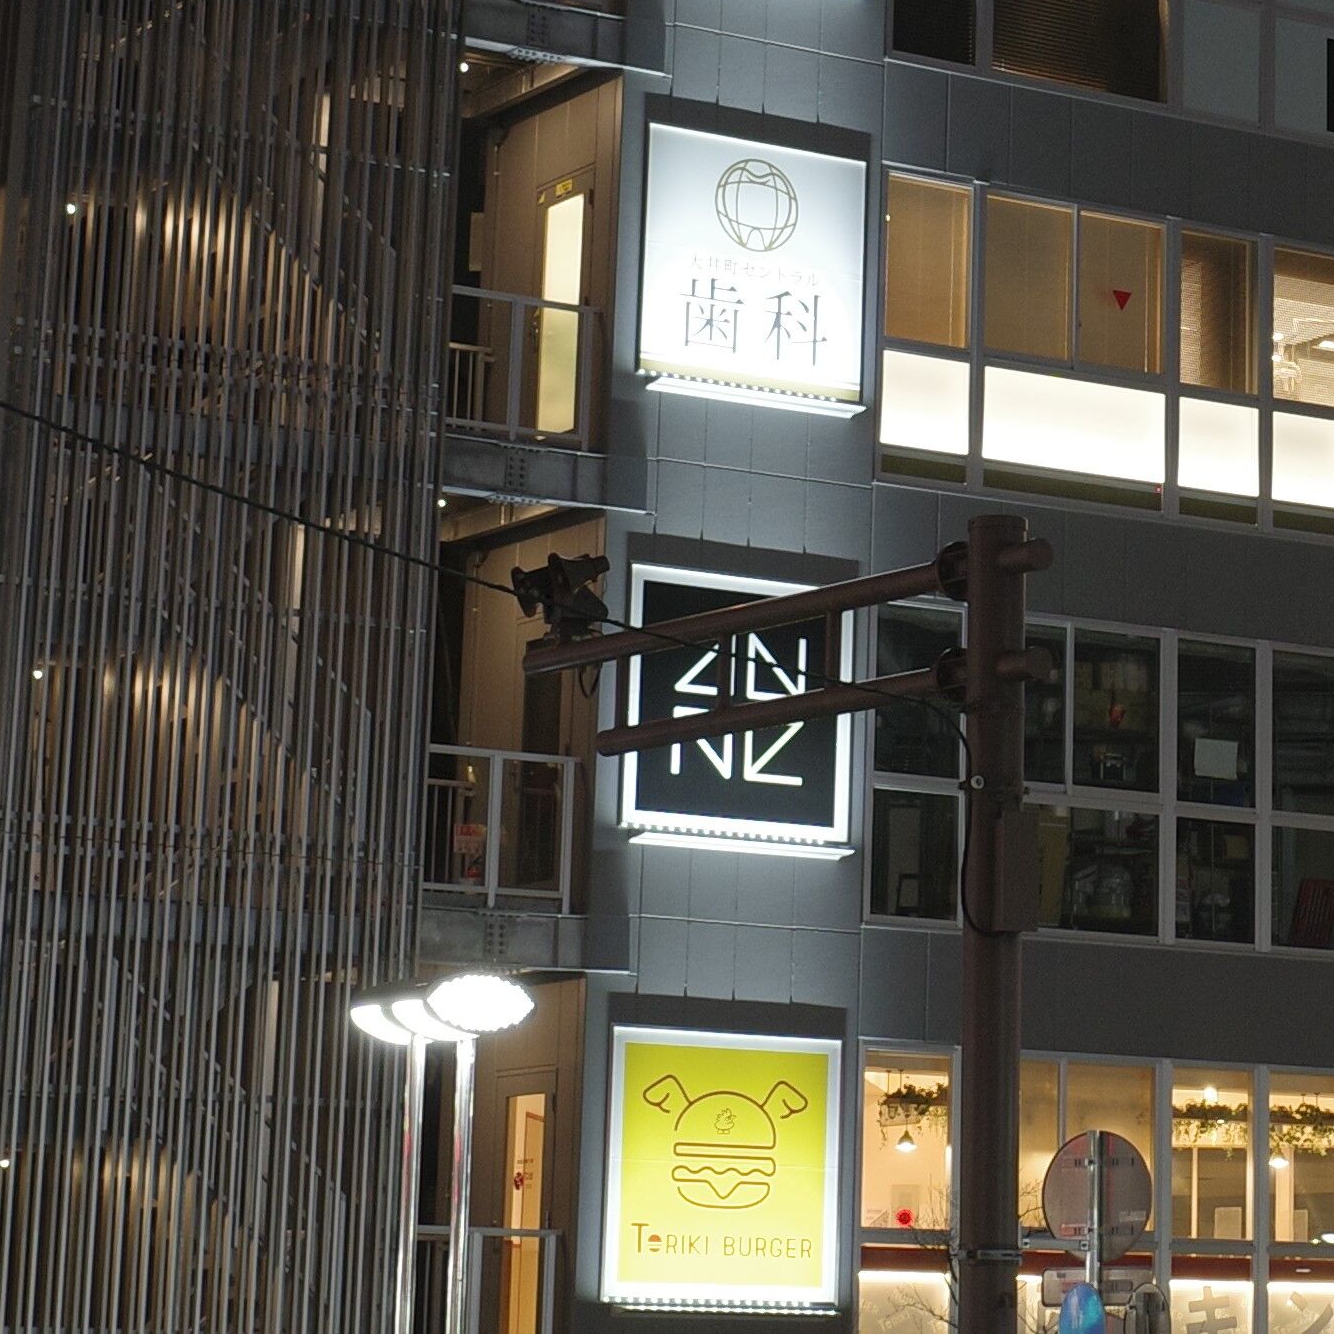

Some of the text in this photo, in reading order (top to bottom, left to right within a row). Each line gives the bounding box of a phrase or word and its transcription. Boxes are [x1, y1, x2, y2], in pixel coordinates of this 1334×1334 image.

[679, 277, 828, 367] 歯科
[630, 1222, 813, 1258] TORIKI BURGER
